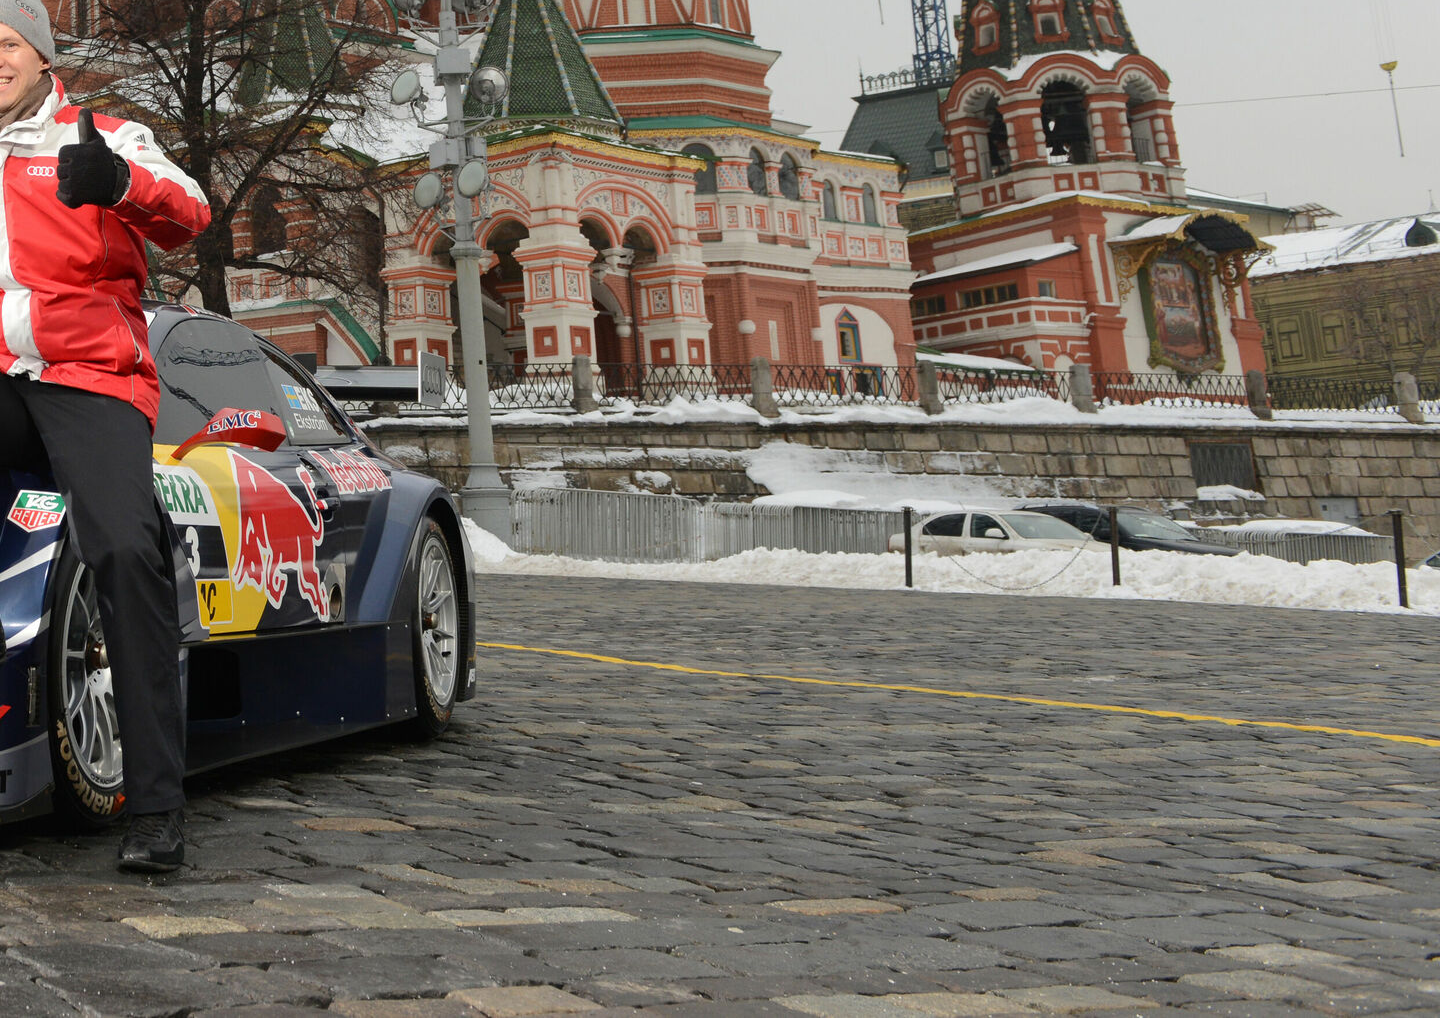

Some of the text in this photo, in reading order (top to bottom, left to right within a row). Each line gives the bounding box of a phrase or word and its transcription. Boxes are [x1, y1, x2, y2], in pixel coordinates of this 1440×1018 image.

[293, 386, 320, 413] EKS
[293, 412, 329, 431] Ekström
[25, 493, 59, 511] TAG
[13, 509, 58, 528] HEUER
[185, 525, 201, 578] 3
